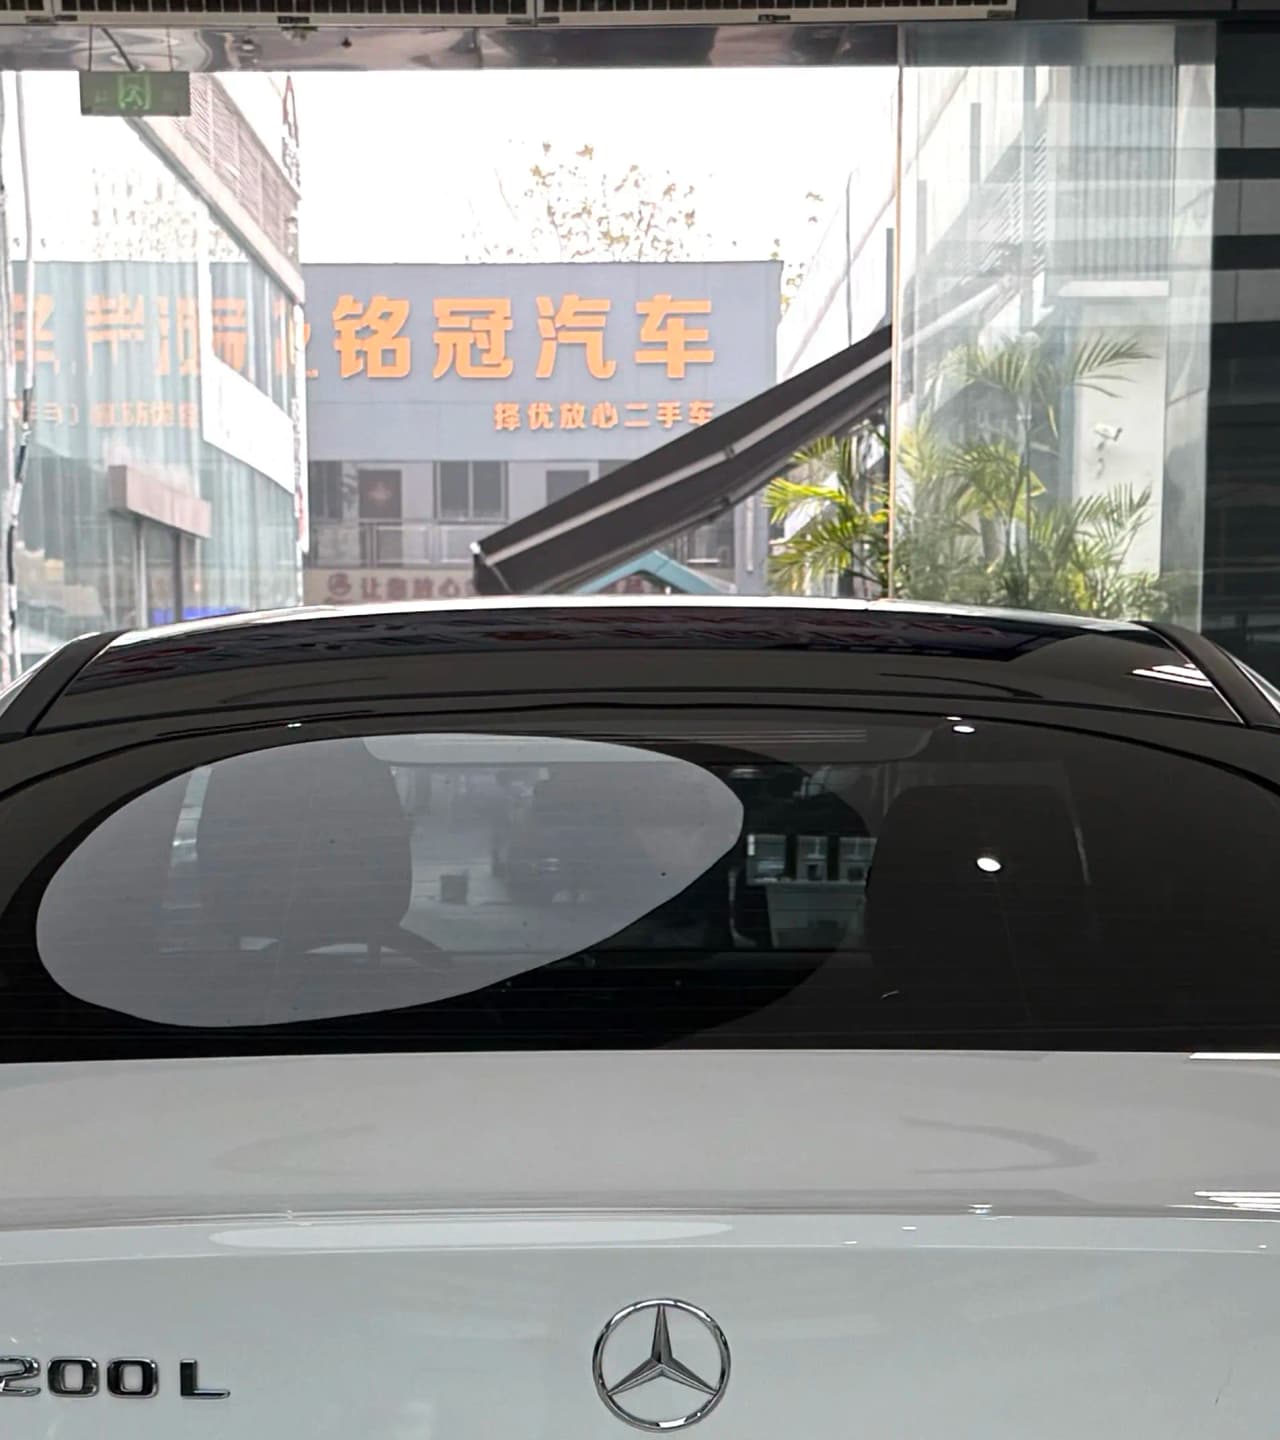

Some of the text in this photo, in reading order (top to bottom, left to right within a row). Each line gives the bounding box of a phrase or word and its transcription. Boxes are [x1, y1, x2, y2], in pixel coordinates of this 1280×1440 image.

[332, 294, 715, 380] 铭冠汽车
[493, 400, 715, 431] 择优放心二手车
[179, 1359, 231, 1400] L
